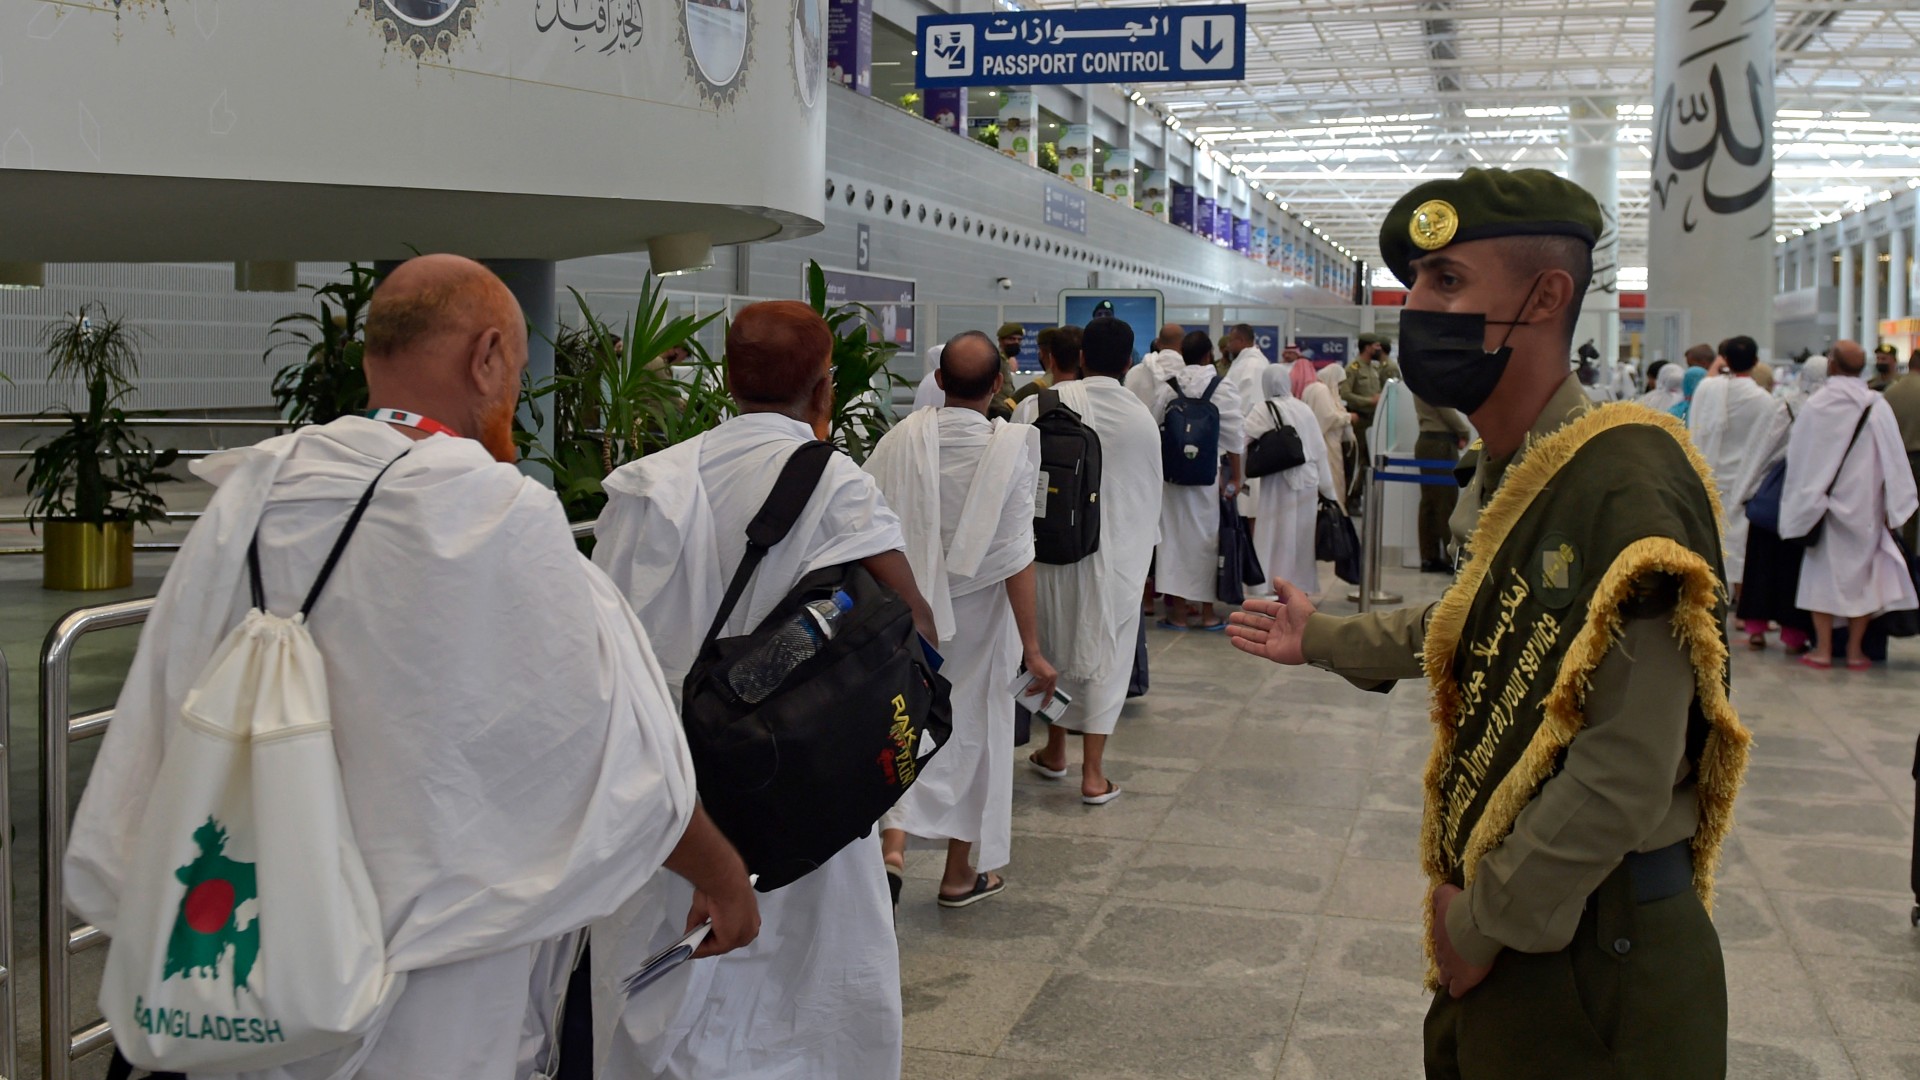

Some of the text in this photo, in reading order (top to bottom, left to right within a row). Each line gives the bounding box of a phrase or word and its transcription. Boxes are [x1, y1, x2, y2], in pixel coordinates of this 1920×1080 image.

[985, 15, 1170, 46] الجوازات
[982, 50, 1170, 76] PASSPORT CONTROL
[859, 230, 869, 265] 5
[1322, 340, 1344, 354] stc
[1459, 718, 1500, 788] Airport
[1490, 701, 1509, 735] at
[1500, 667, 1530, 726] your
[1518, 612, 1561, 681] service
[891, 694, 917, 748] RAK
